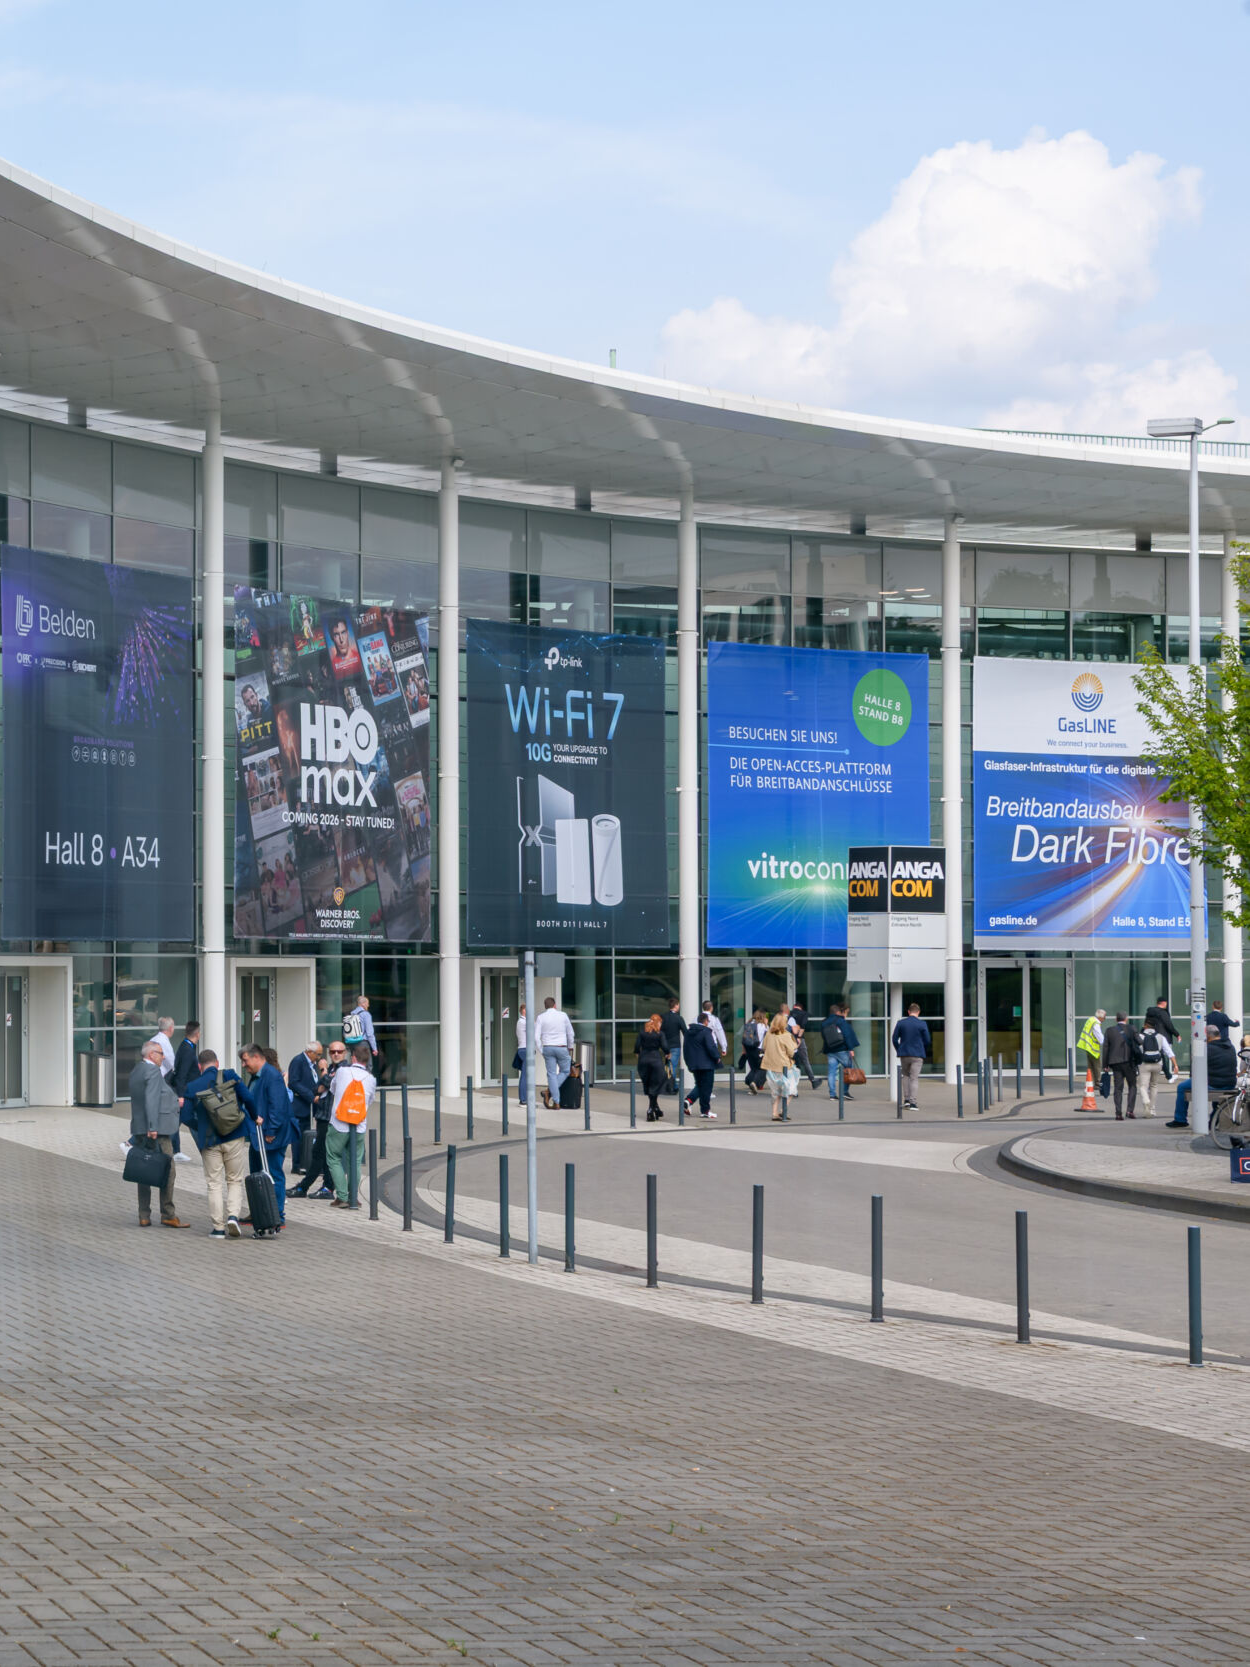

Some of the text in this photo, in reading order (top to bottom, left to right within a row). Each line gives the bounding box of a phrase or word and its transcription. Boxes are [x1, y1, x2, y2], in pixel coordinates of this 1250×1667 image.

[39, 605, 96, 640] Belden
[560, 655, 583, 668] tp-link
[504, 684, 625, 740] Wi-Fi 7
[864, 693, 901, 712] HALLE 8
[858, 706, 904, 726] STAND B8
[1058, 717, 1117, 734] GasLINE
[240, 721, 272, 743] PITT
[300, 702, 379, 765] HBO
[729, 726, 838, 744] BESUCHEN SIE UNS!
[525, 742, 608, 763] 10G YOUR UPGRADE TO
[1047, 739, 1128, 750] We connect your business.
[553, 754, 598, 766] CONNECTIVITY
[730, 756, 892, 776] DIE OPEN-ACCES-PLATTFORM
[984, 760, 1088, 774] Glasfaser-Infrastruktur
[1090, 762, 1102, 774] für
[1105, 764, 1120, 774] die
[1122, 764, 1156, 776] digitale
[301, 765, 378, 808] max
[730, 772, 893, 794] FÜR BREITBANDANSCHLÜSSE
[986, 796, 1146, 820] Breitbandausbau
[281, 811, 318, 826] COMING
[320, 813, 340, 826] 2026
[345, 814, 365, 827] STAY
[366, 815, 395, 830] TUNED!
[45, 831, 161, 869] Hall 8 A34
[1011, 824, 1191, 866] Dark Fibre
[748, 852, 849, 880] vitrocon
[849, 861, 888, 879] ANGA
[891, 861, 944, 880] ANGA
[849, 880, 878, 898] COM
[891, 880, 933, 898] COM
[315, 909, 361, 920] WARNER BROS.
[320, 918, 355, 929] DISCOVERY
[536, 920, 560, 928] BOOTH
[562, 920, 576, 928] D11
[584, 920, 601, 928] HALL
[989, 915, 1038, 926] gasline.de
[1112, 916, 1136, 926] Halle
[1138, 916, 1147, 928] 8,
[1149, 916, 1176, 928] Stand
